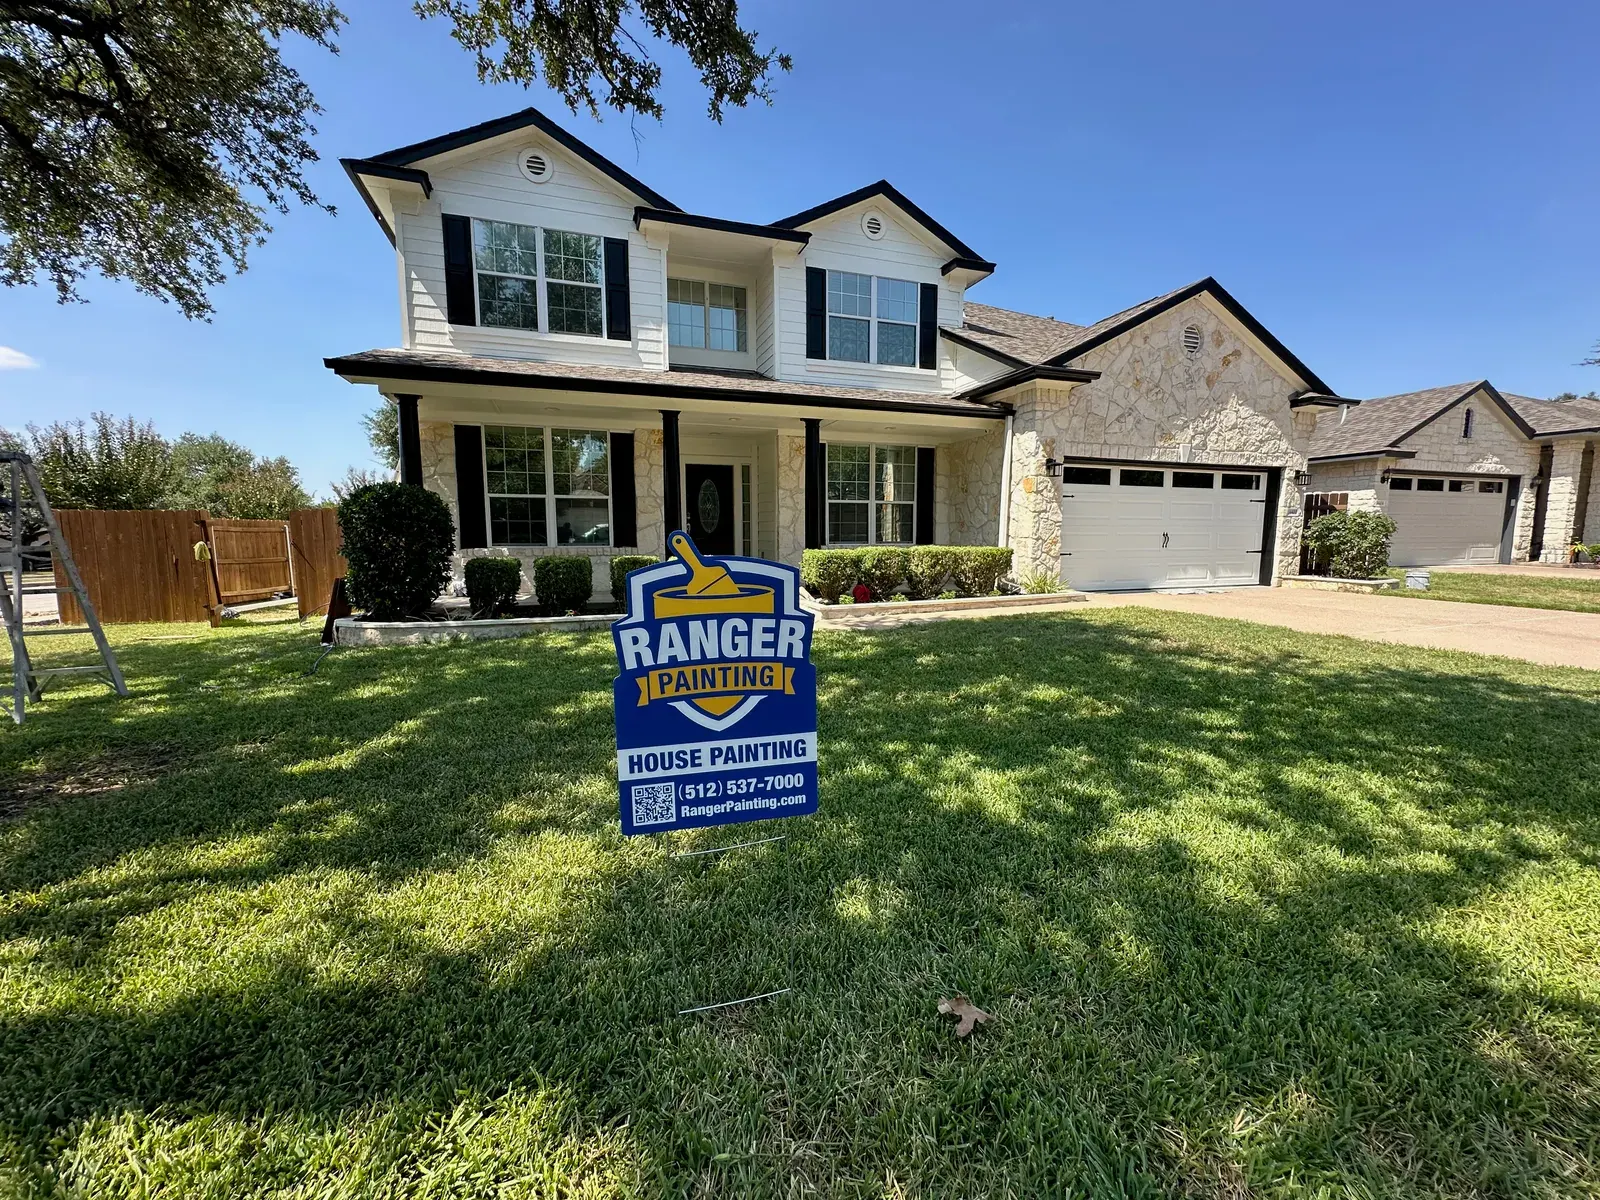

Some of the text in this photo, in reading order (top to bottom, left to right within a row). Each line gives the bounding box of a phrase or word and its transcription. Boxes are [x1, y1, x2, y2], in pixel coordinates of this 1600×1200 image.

[619, 618, 806, 670] RANGER
[658, 665, 774, 695] PAINTING
[628, 739, 807, 774] HOUSE PAINTING
[678, 773, 804, 801] (512) 537-7000
[681, 794, 807, 818] RangerPainting.com
